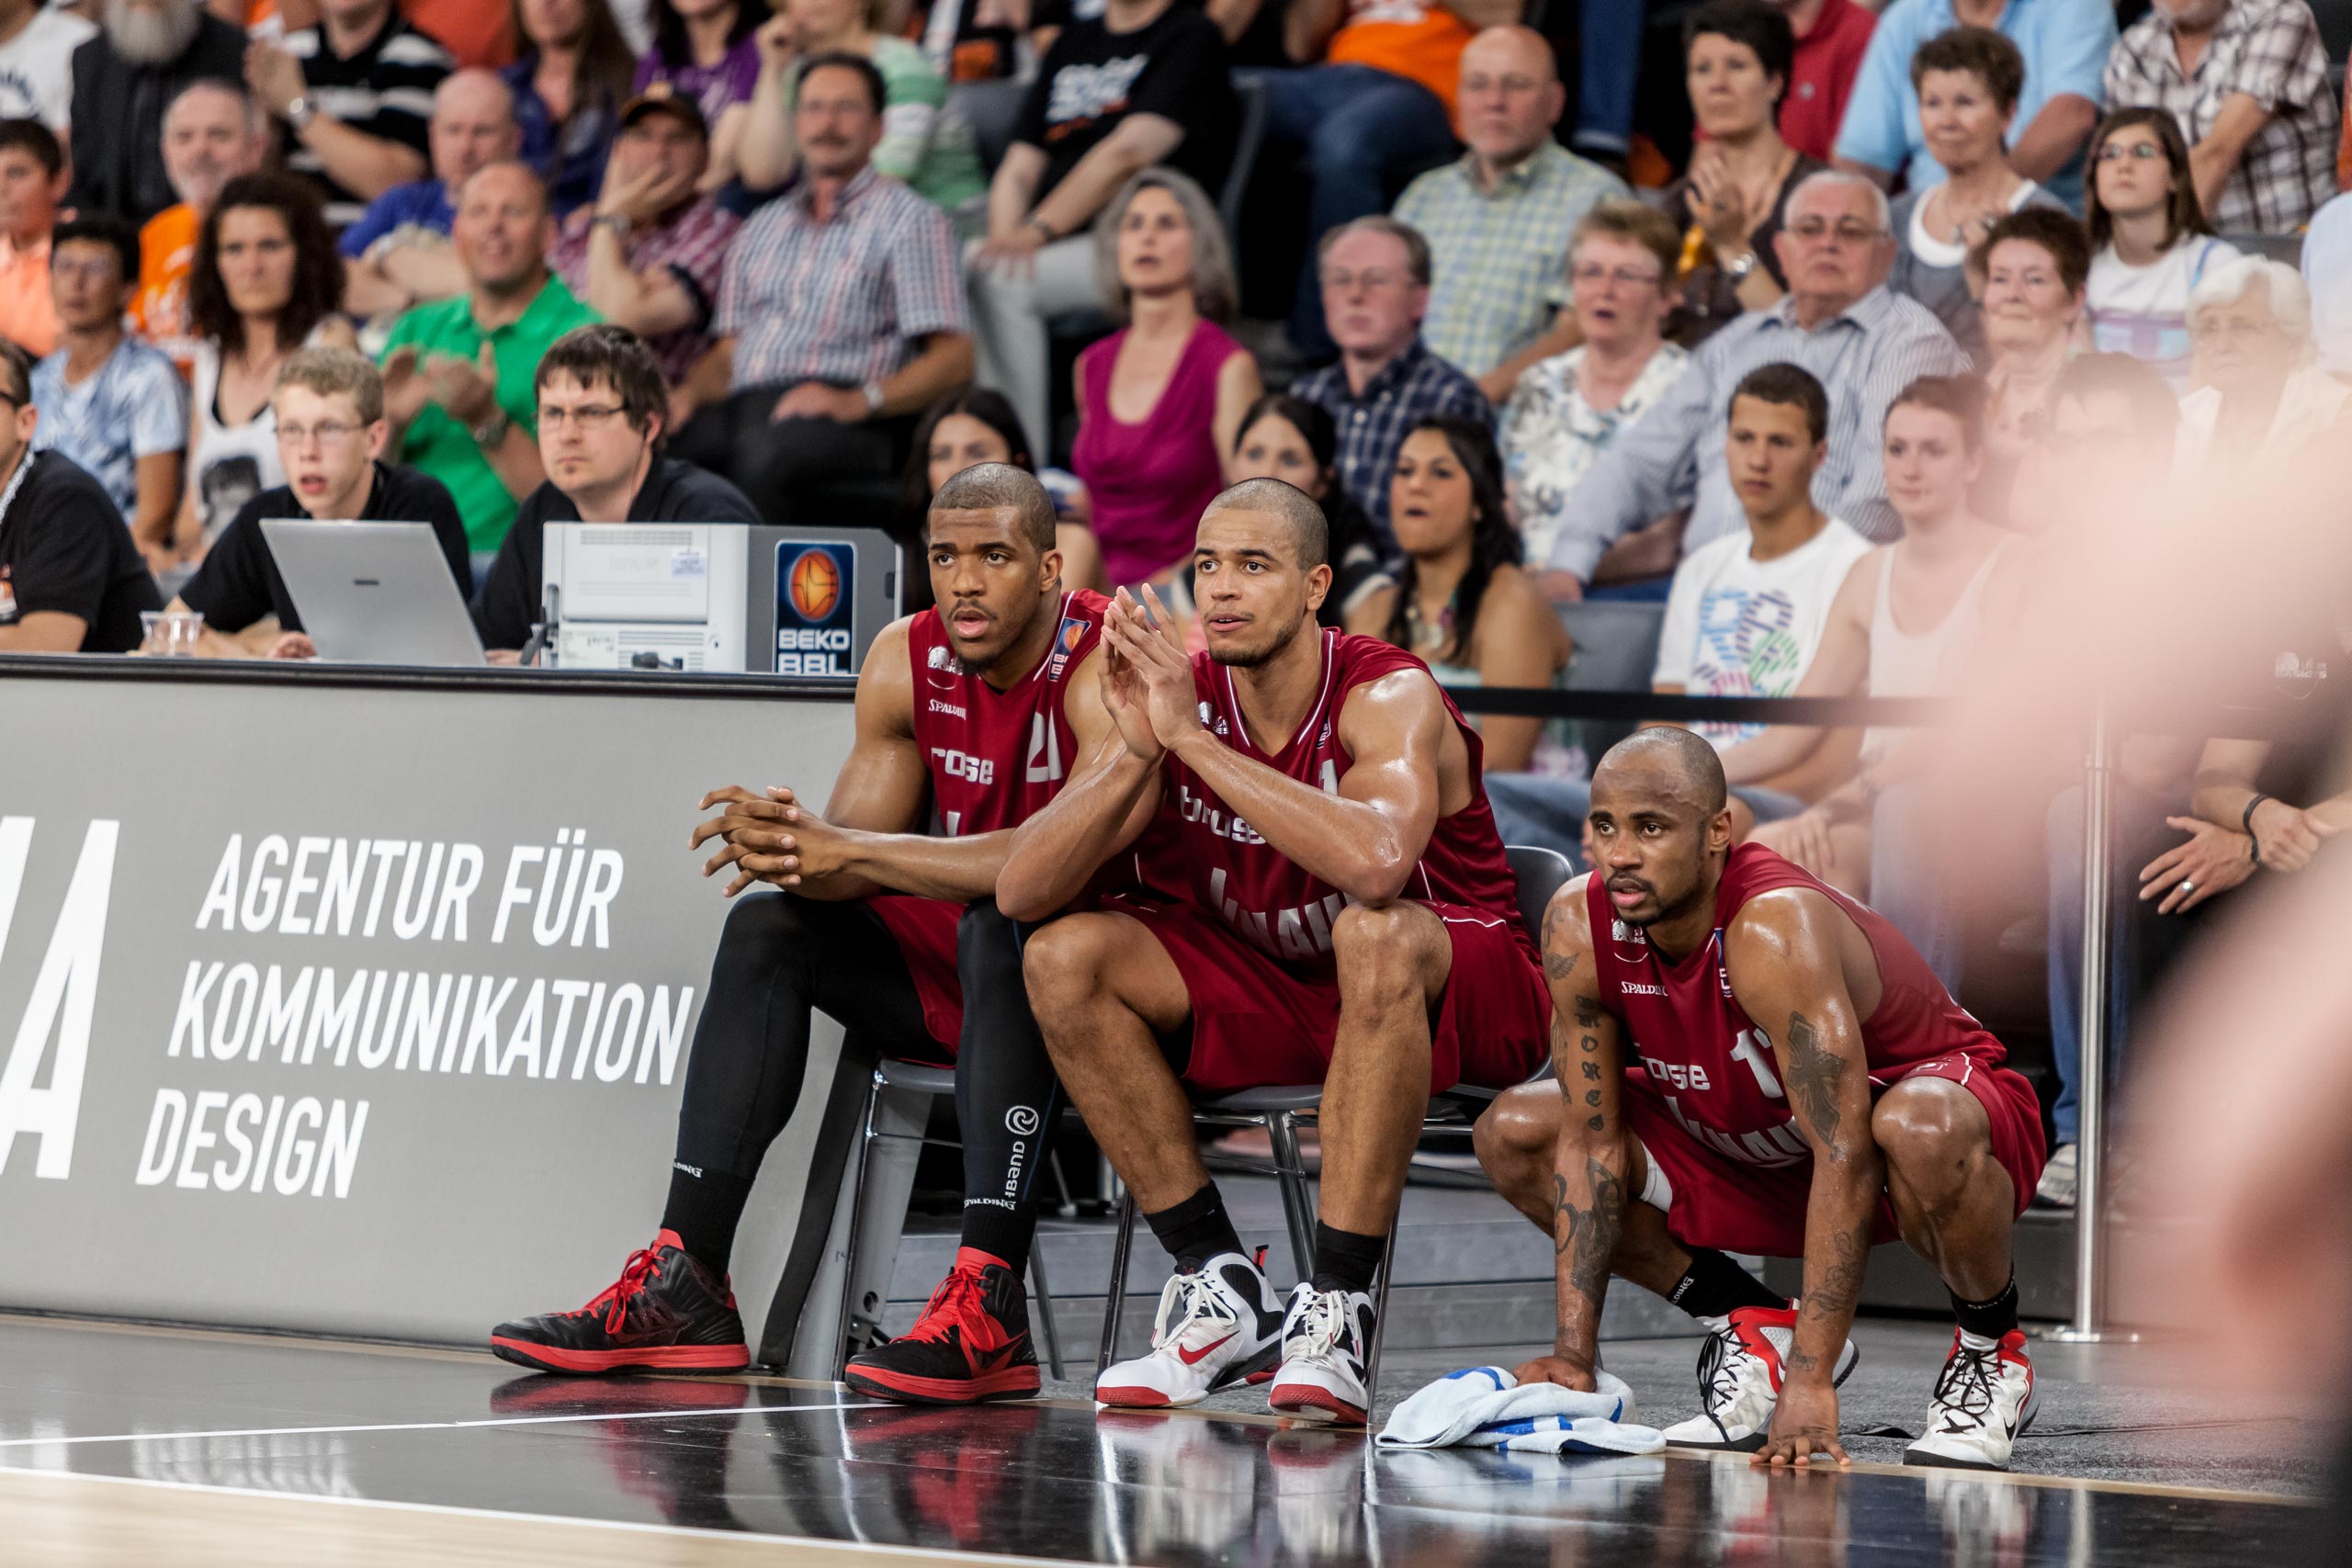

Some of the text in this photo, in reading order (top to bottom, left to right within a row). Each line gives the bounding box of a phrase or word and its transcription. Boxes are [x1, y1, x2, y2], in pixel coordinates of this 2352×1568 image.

[777, 653, 851, 674] BBL
[778, 628, 851, 650] BEKO
[195, 828, 624, 949] AGENTUR FÜR
[167, 961, 695, 1086] KOMMUNIKATION
[135, 1088, 369, 1200] DESIGN
